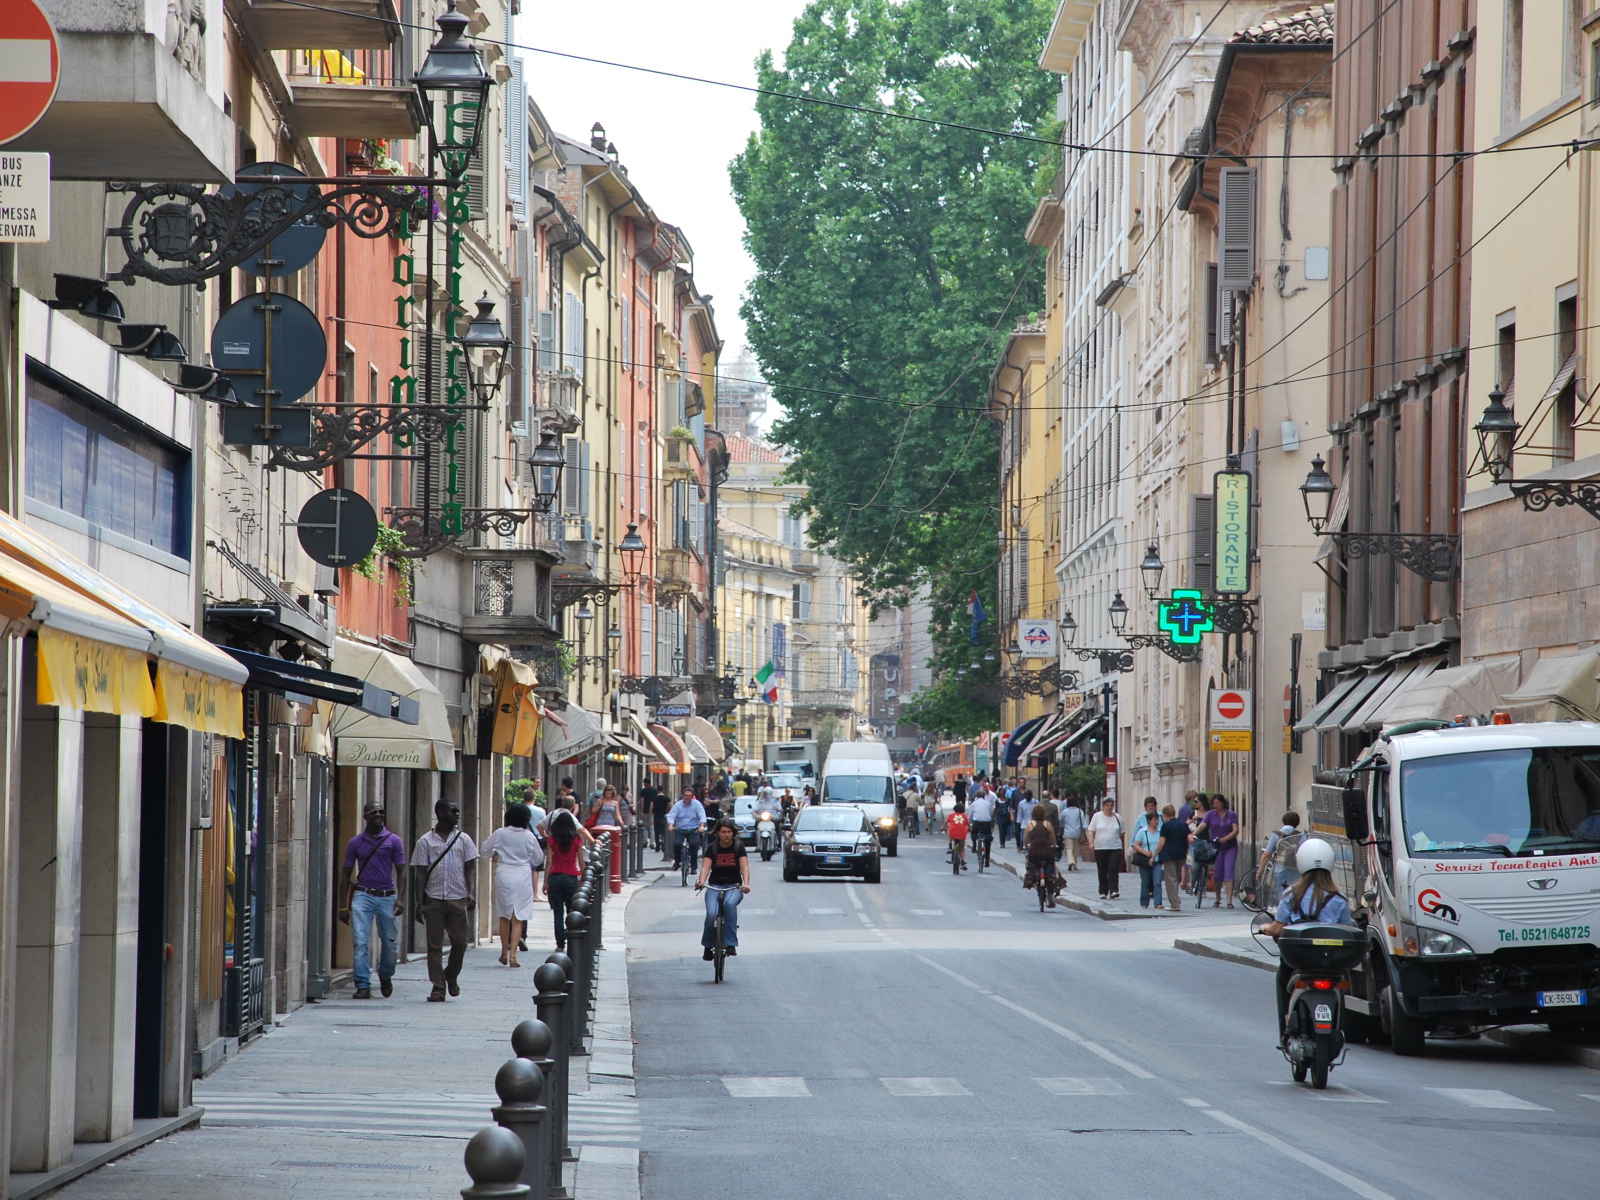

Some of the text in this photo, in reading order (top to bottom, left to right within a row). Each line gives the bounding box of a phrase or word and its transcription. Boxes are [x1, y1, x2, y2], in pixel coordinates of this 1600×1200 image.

[2, 157, 22, 170] BUS
[1224, 479, 1240, 586] RISTORANTE
[1065, 696, 1081, 709] BAR
[347, 743, 421, 763] Pasticceria
[1434, 862, 1484, 872] Servizi
[1490, 859, 1564, 872] Tecnologici
[1443, 918, 1459, 927] FOGNE
[1498, 926, 1591, 942] Tel. 0521/648725
